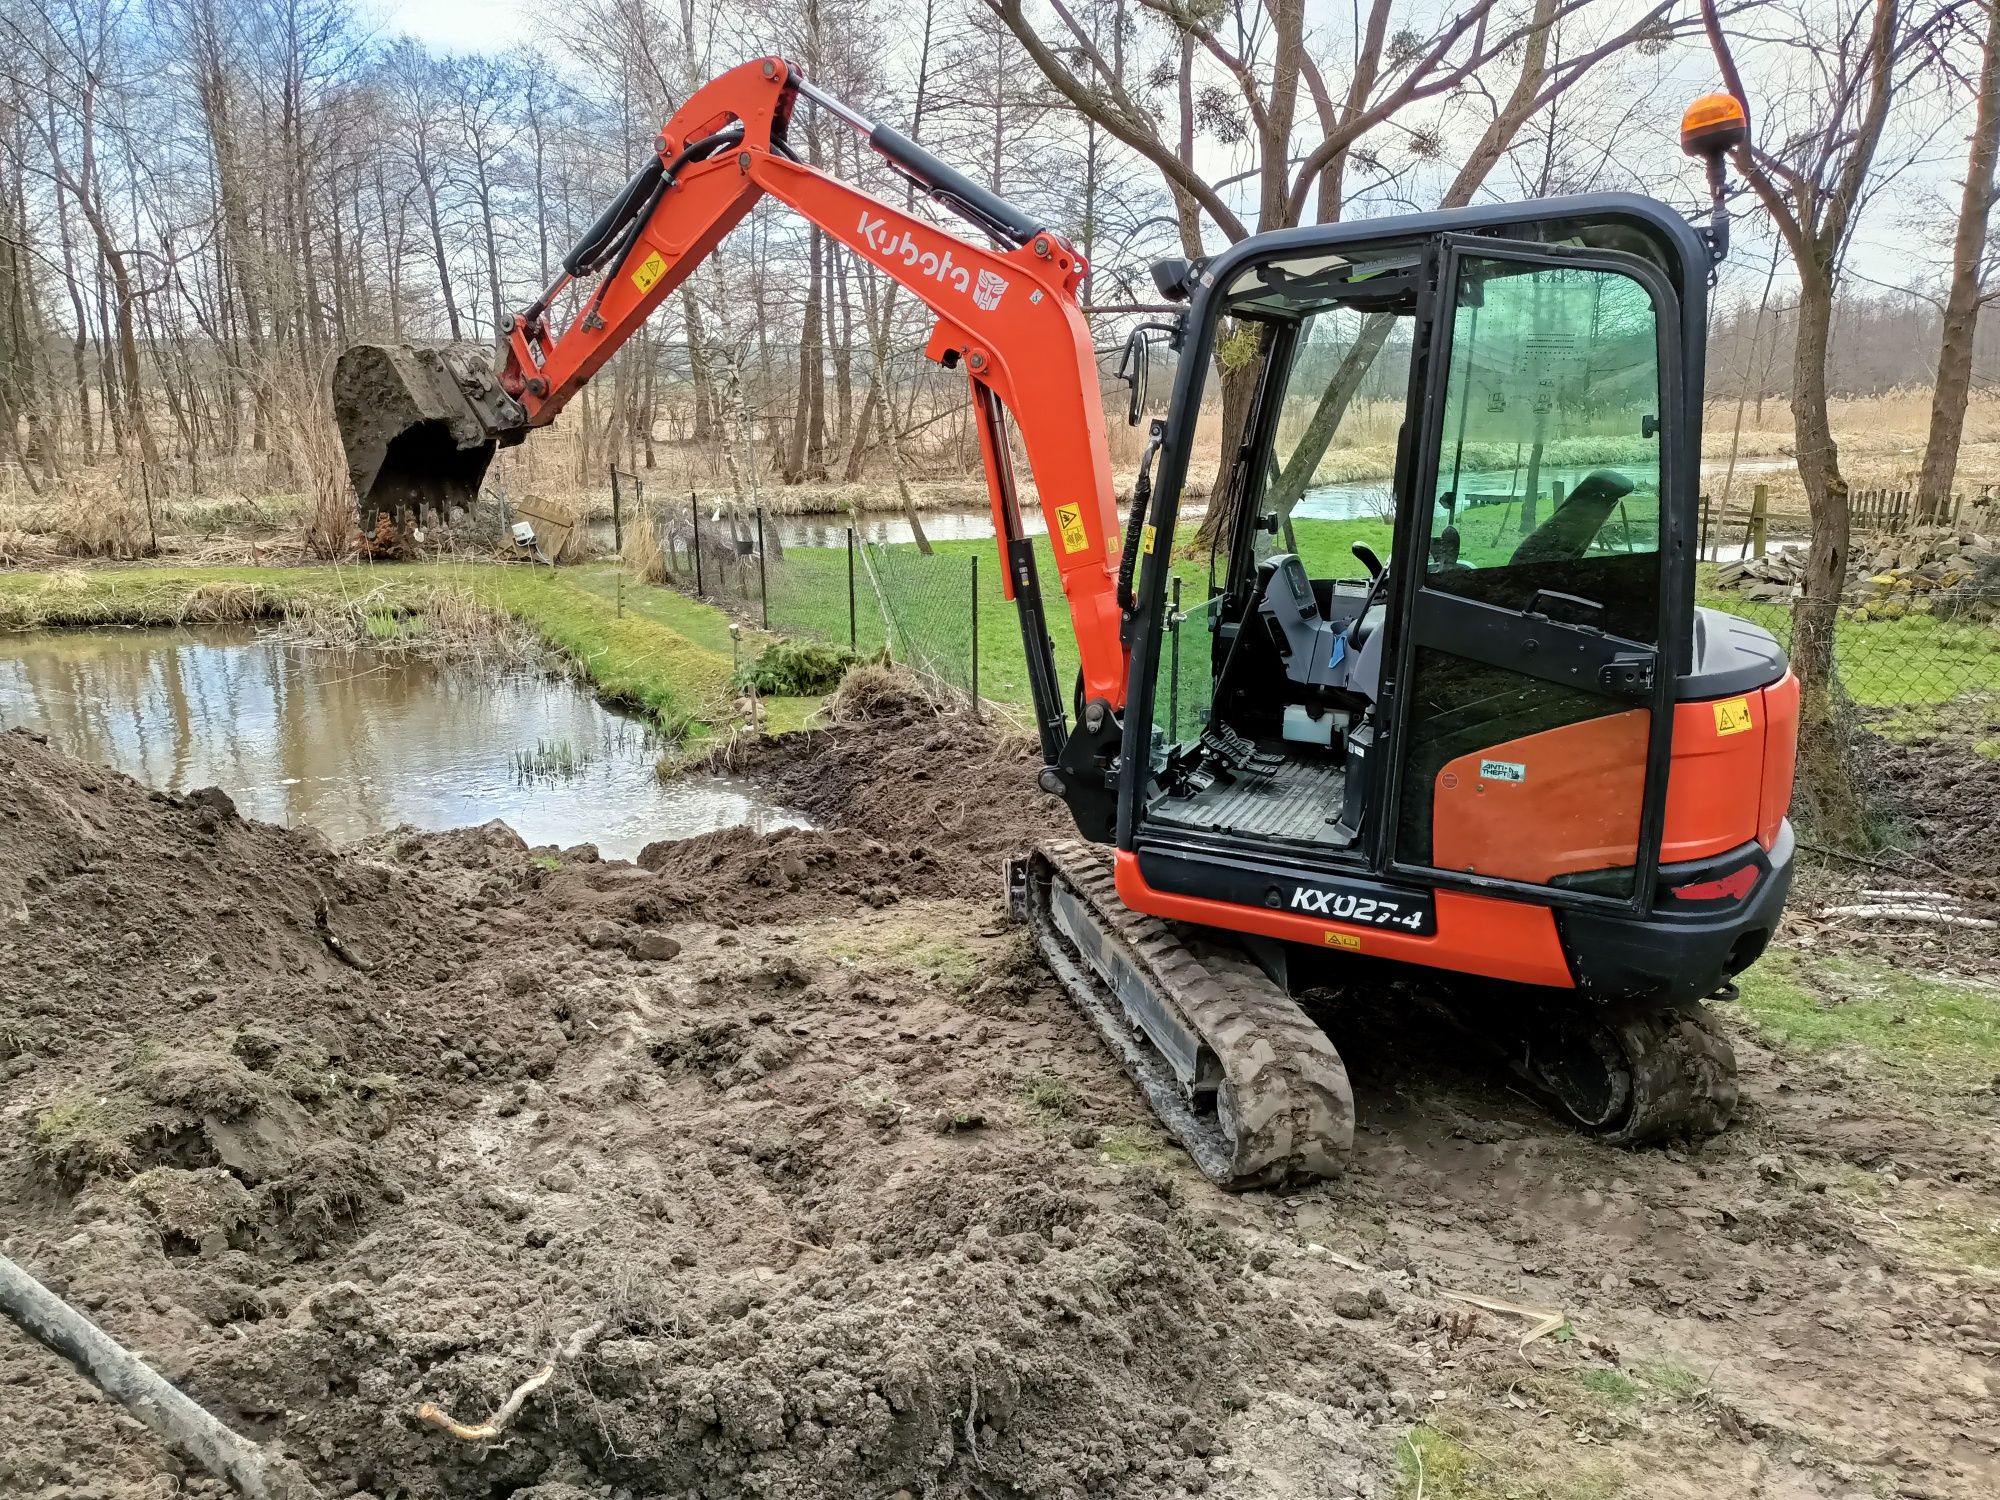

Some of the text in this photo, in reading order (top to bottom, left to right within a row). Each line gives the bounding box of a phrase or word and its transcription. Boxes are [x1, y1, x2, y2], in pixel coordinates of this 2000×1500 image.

[856, 211, 970, 293] Kubota
[1482, 768, 1507, 777] THEFT
[1291, 887, 1423, 929] KX027-4
